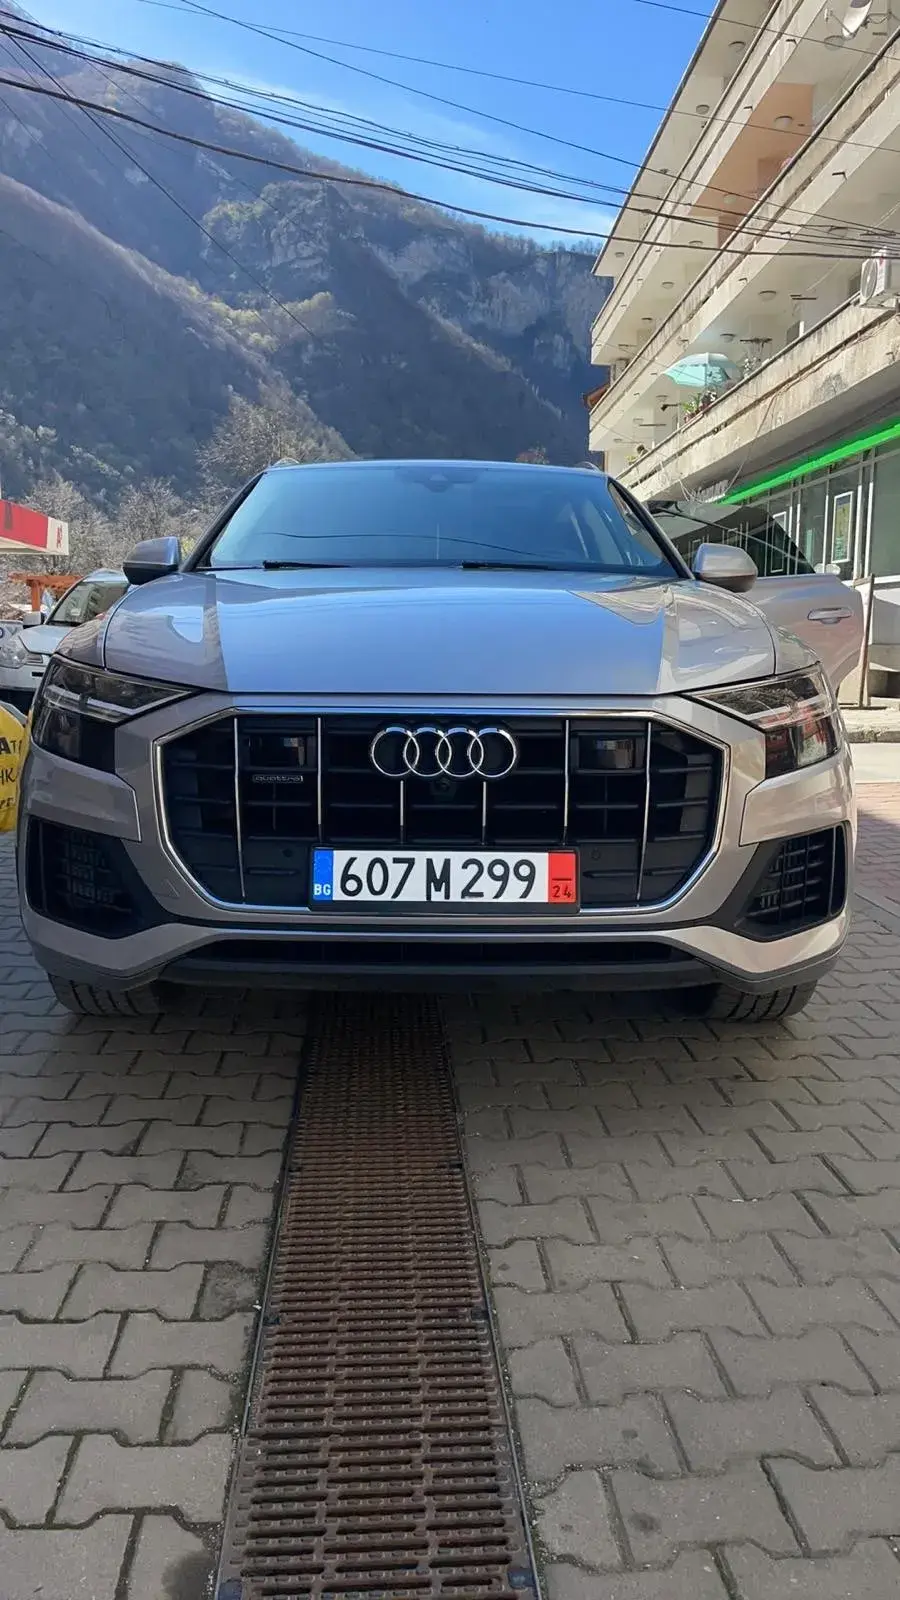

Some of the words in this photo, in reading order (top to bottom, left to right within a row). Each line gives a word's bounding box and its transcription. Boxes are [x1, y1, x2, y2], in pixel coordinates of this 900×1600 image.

[340, 857, 416, 899] 607
[426, 858, 451, 901] M
[461, 858, 537, 900] 299
[313, 883, 331, 896] BG
[552, 884, 572, 898] 24
